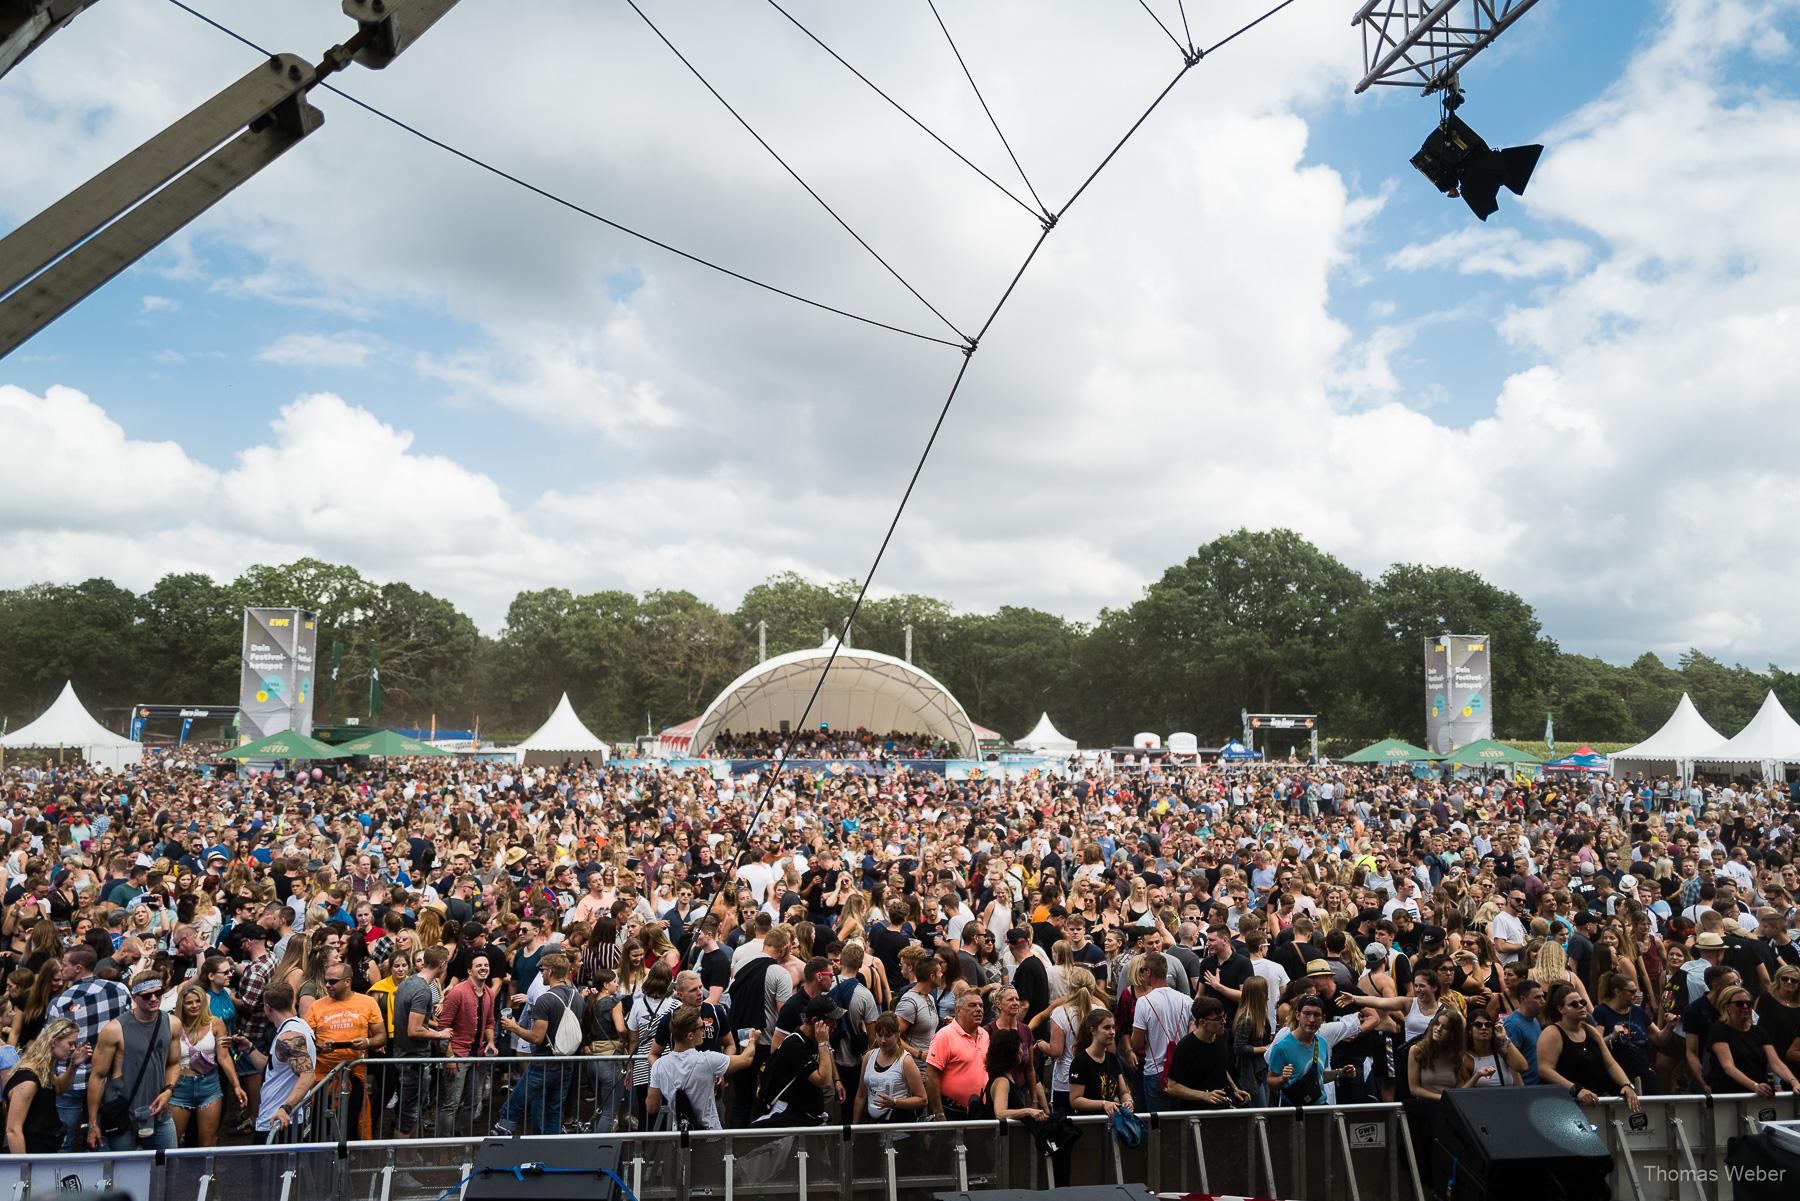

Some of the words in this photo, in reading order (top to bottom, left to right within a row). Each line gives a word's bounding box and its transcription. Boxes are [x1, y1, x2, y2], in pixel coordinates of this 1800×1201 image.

[251, 644, 270, 653] Dein
[250, 653, 286, 661] Festival-
[249, 661, 283, 671] hotspot
